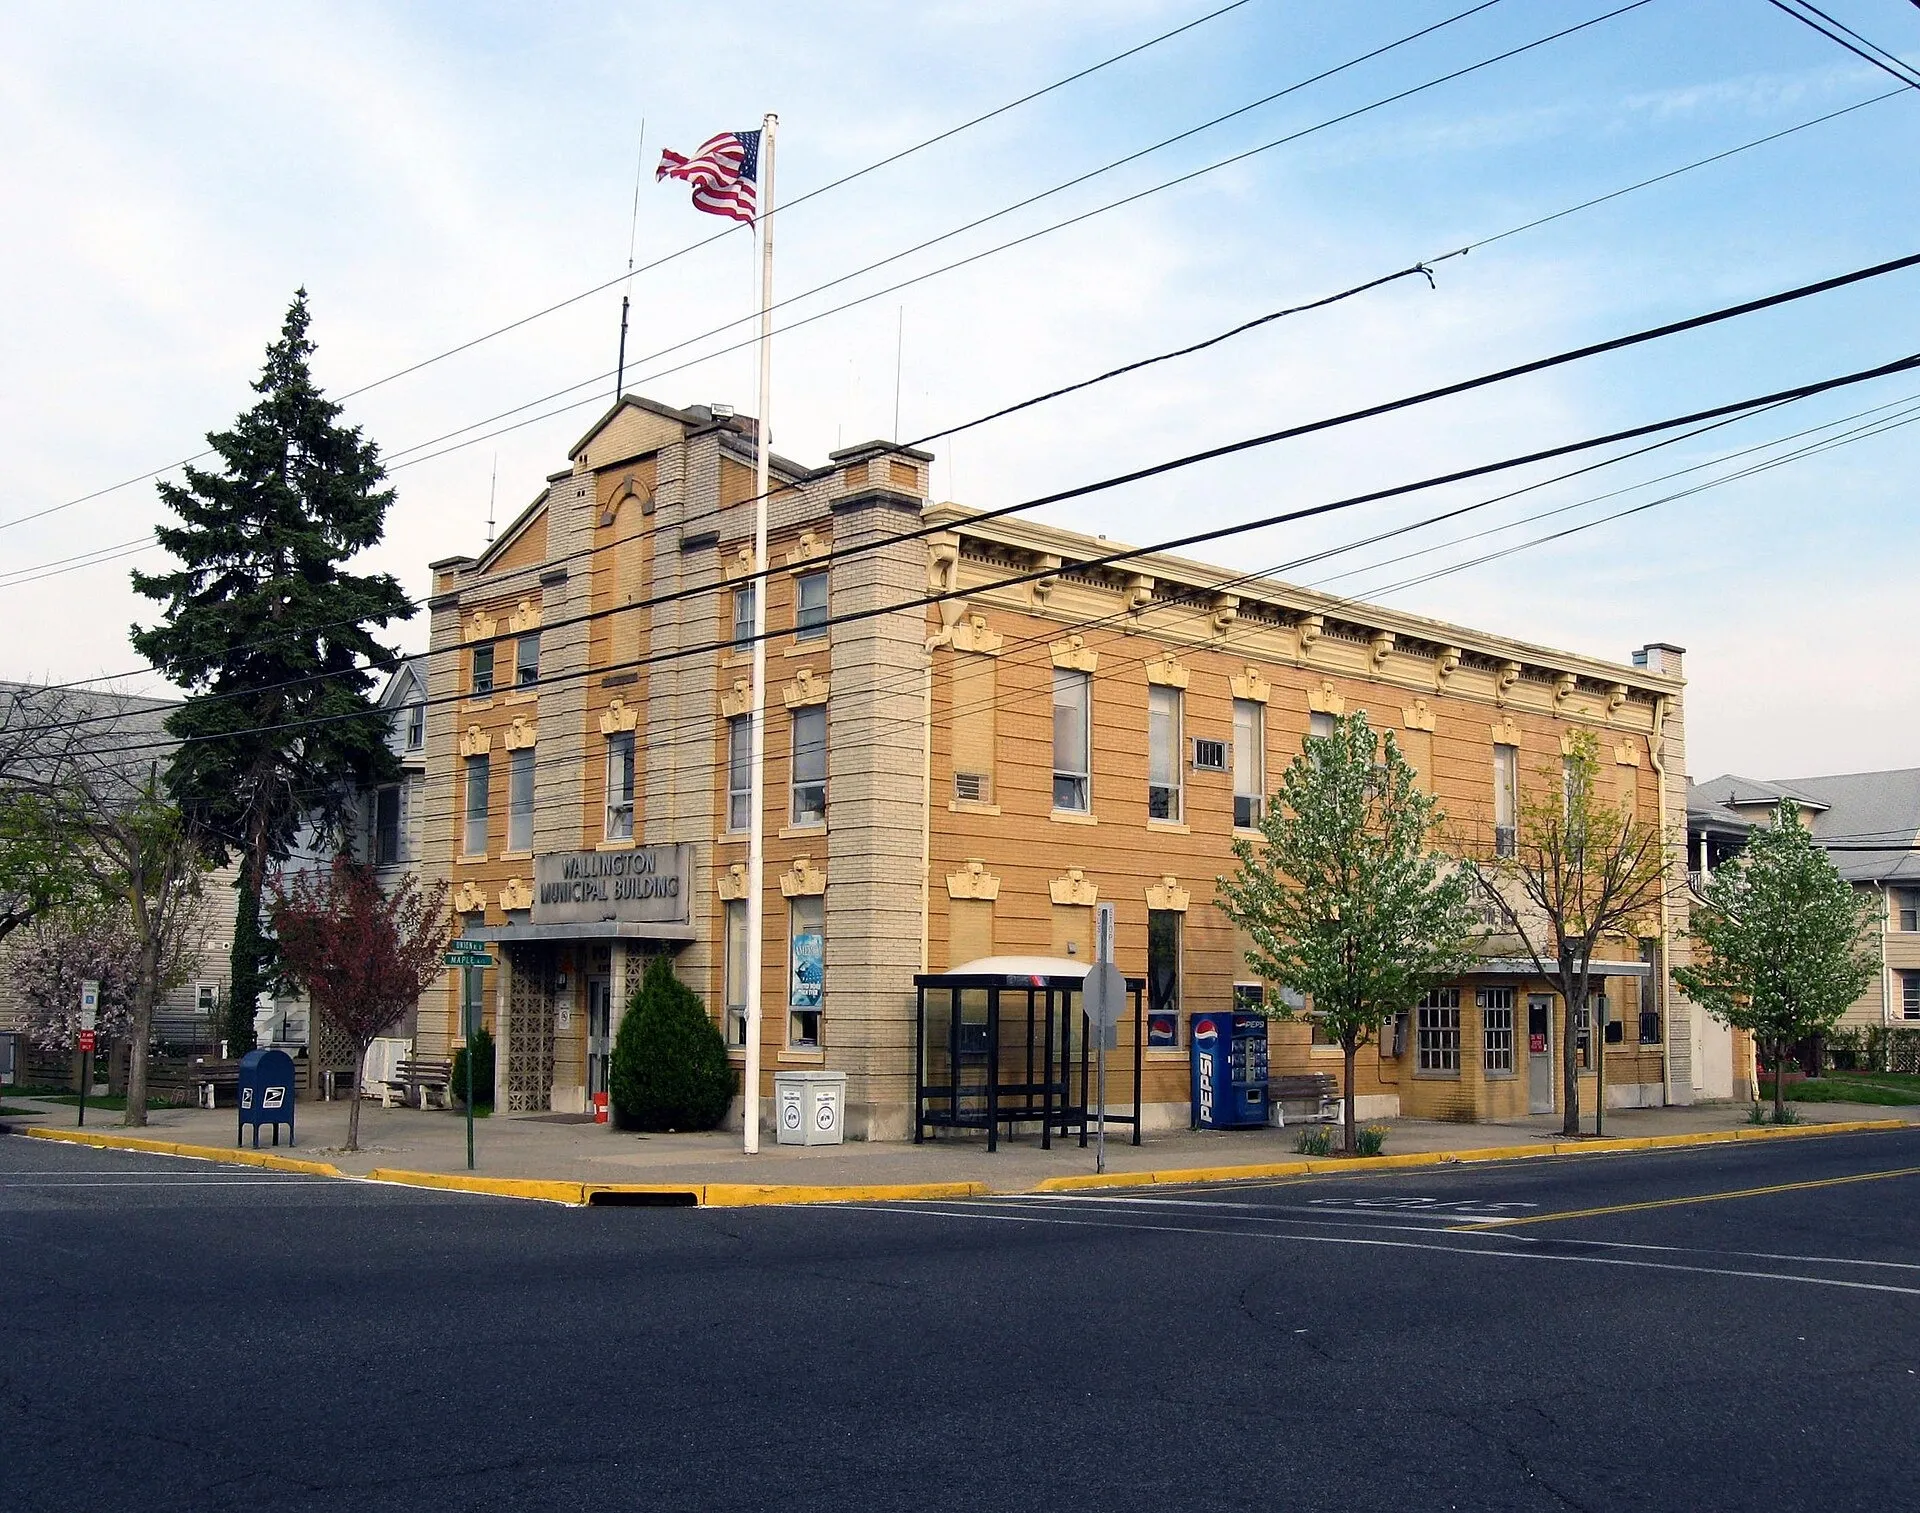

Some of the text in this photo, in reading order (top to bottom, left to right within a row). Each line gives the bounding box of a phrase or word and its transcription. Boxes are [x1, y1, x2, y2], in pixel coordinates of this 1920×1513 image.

[561, 853, 656, 880] WALLINGTON
[540, 875, 679, 905] MUNICIPAL BUILDING
[450, 956, 475, 964] MAPLE
[1245, 1020, 1264, 1028] PEPSI
[1200, 1052, 1213, 1123] PEPSI
